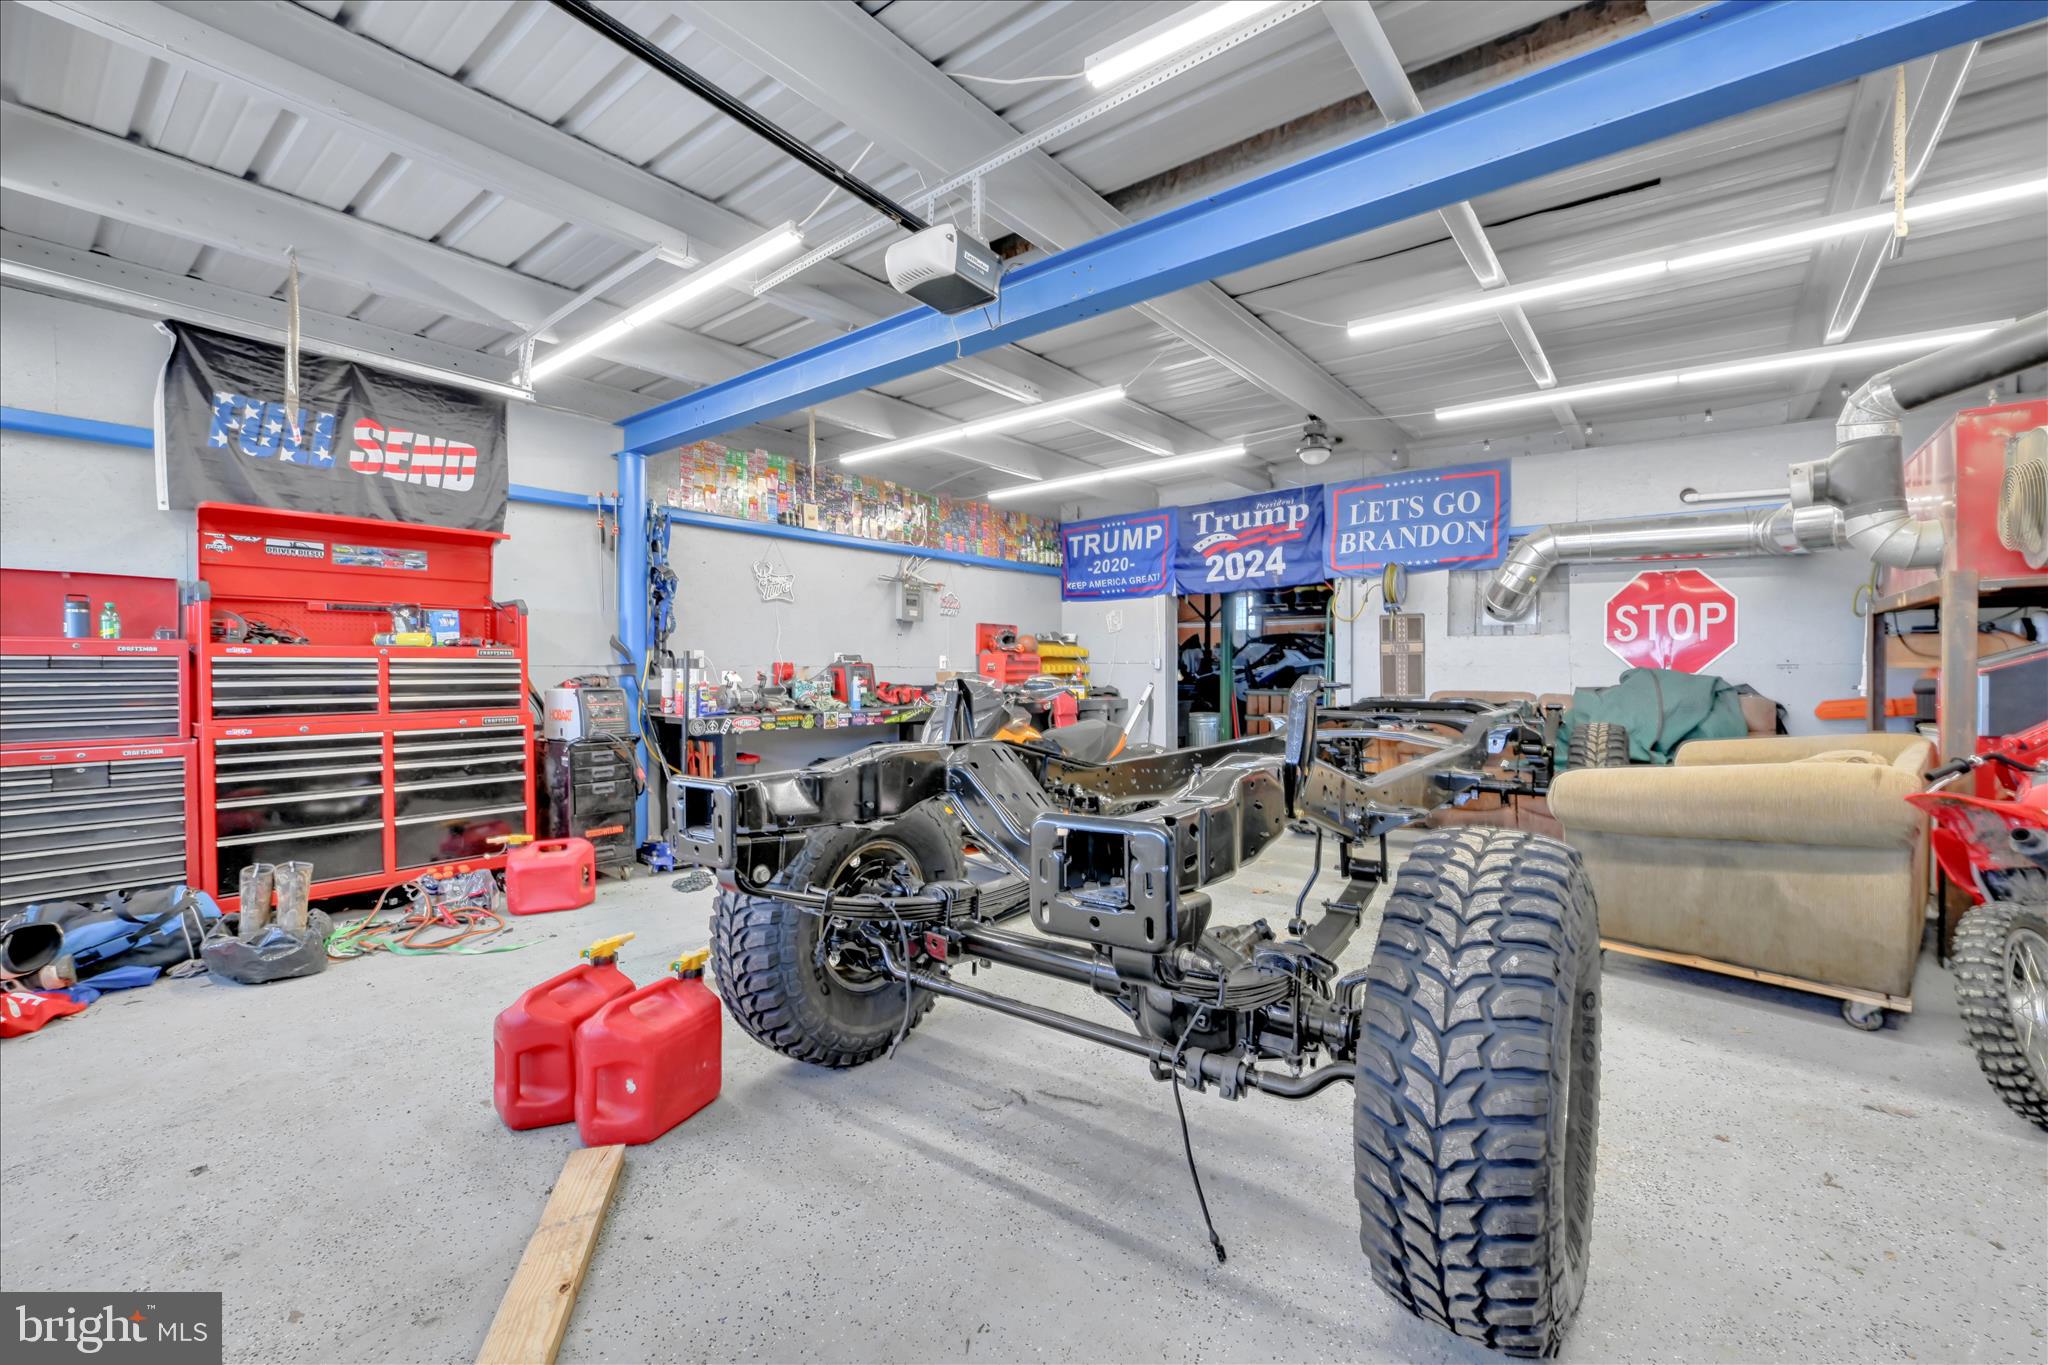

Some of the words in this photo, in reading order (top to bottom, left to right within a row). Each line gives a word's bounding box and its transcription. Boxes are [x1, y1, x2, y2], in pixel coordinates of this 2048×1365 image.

[208, 391, 336, 468] FULL
[350, 417, 478, 492] SEND
[1192, 503, 1310, 535] Trump
[1256, 499, 1295, 510] President
[1350, 495, 1424, 526] LET'S
[1433, 490, 1481, 516] GO
[1068, 525, 1163, 558] TRUMP
[1339, 520, 1488, 555] BRANDON
[1205, 546, 1287, 583] 2024
[1066, 581, 1087, 590] KEEP
[1089, 577, 1127, 589] AMERICA
[1614, 603, 1728, 642] STOP
[484, 717, 517, 725] CRAFTSMAN
